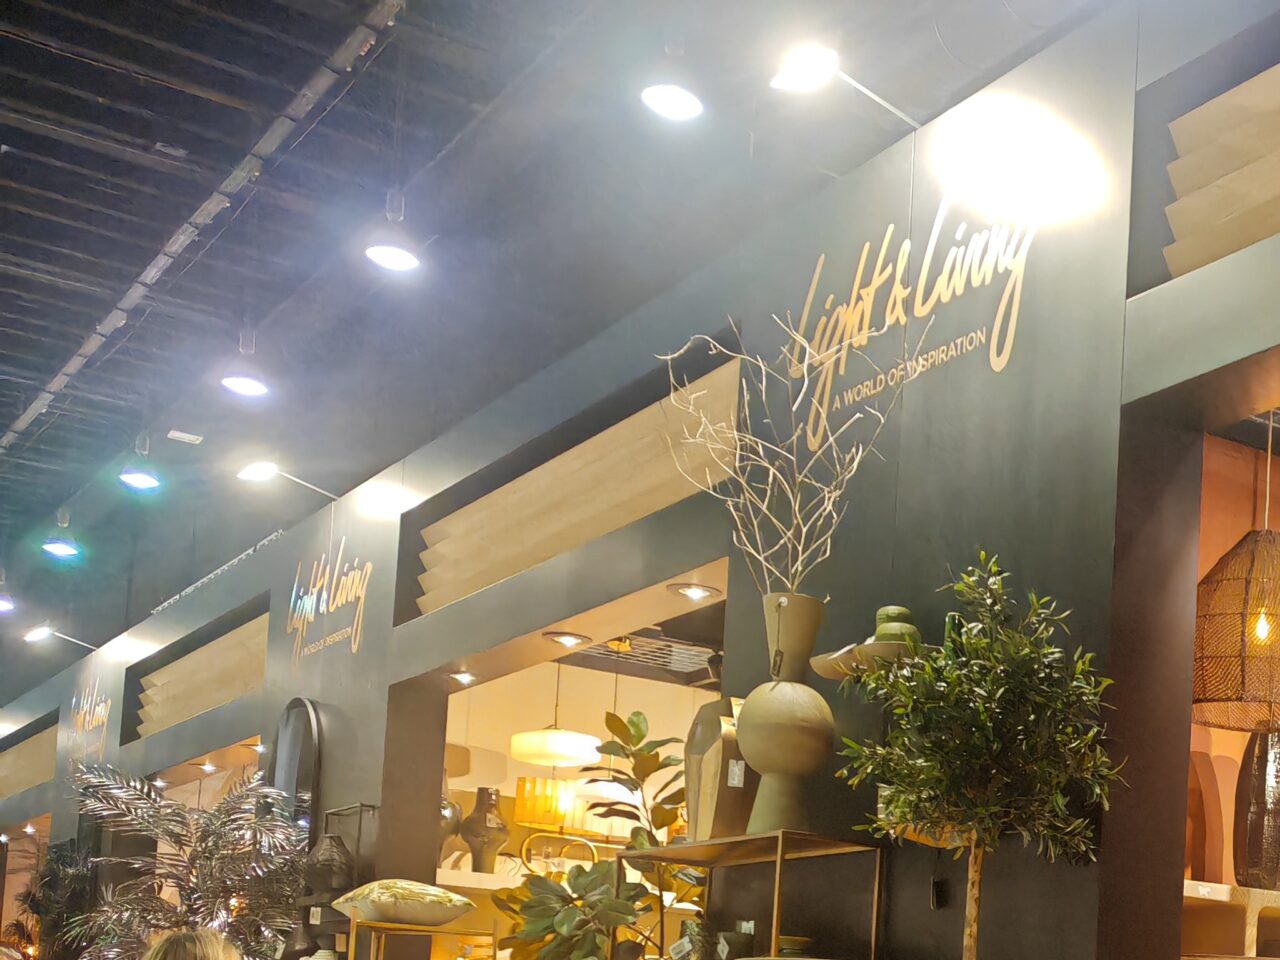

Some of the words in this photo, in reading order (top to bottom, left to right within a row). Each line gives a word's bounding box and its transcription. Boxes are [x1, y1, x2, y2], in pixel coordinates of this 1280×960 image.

[788, 223, 893, 452] Light
[885, 238, 911, 326] &
[832, 395, 841, 412] A
[843, 374, 886, 406] WORLD
[887, 363, 904, 386] OF
[906, 327, 986, 378] INSPIRATION
[286, 553, 324, 671] Light
[329, 535, 373, 653] Living
